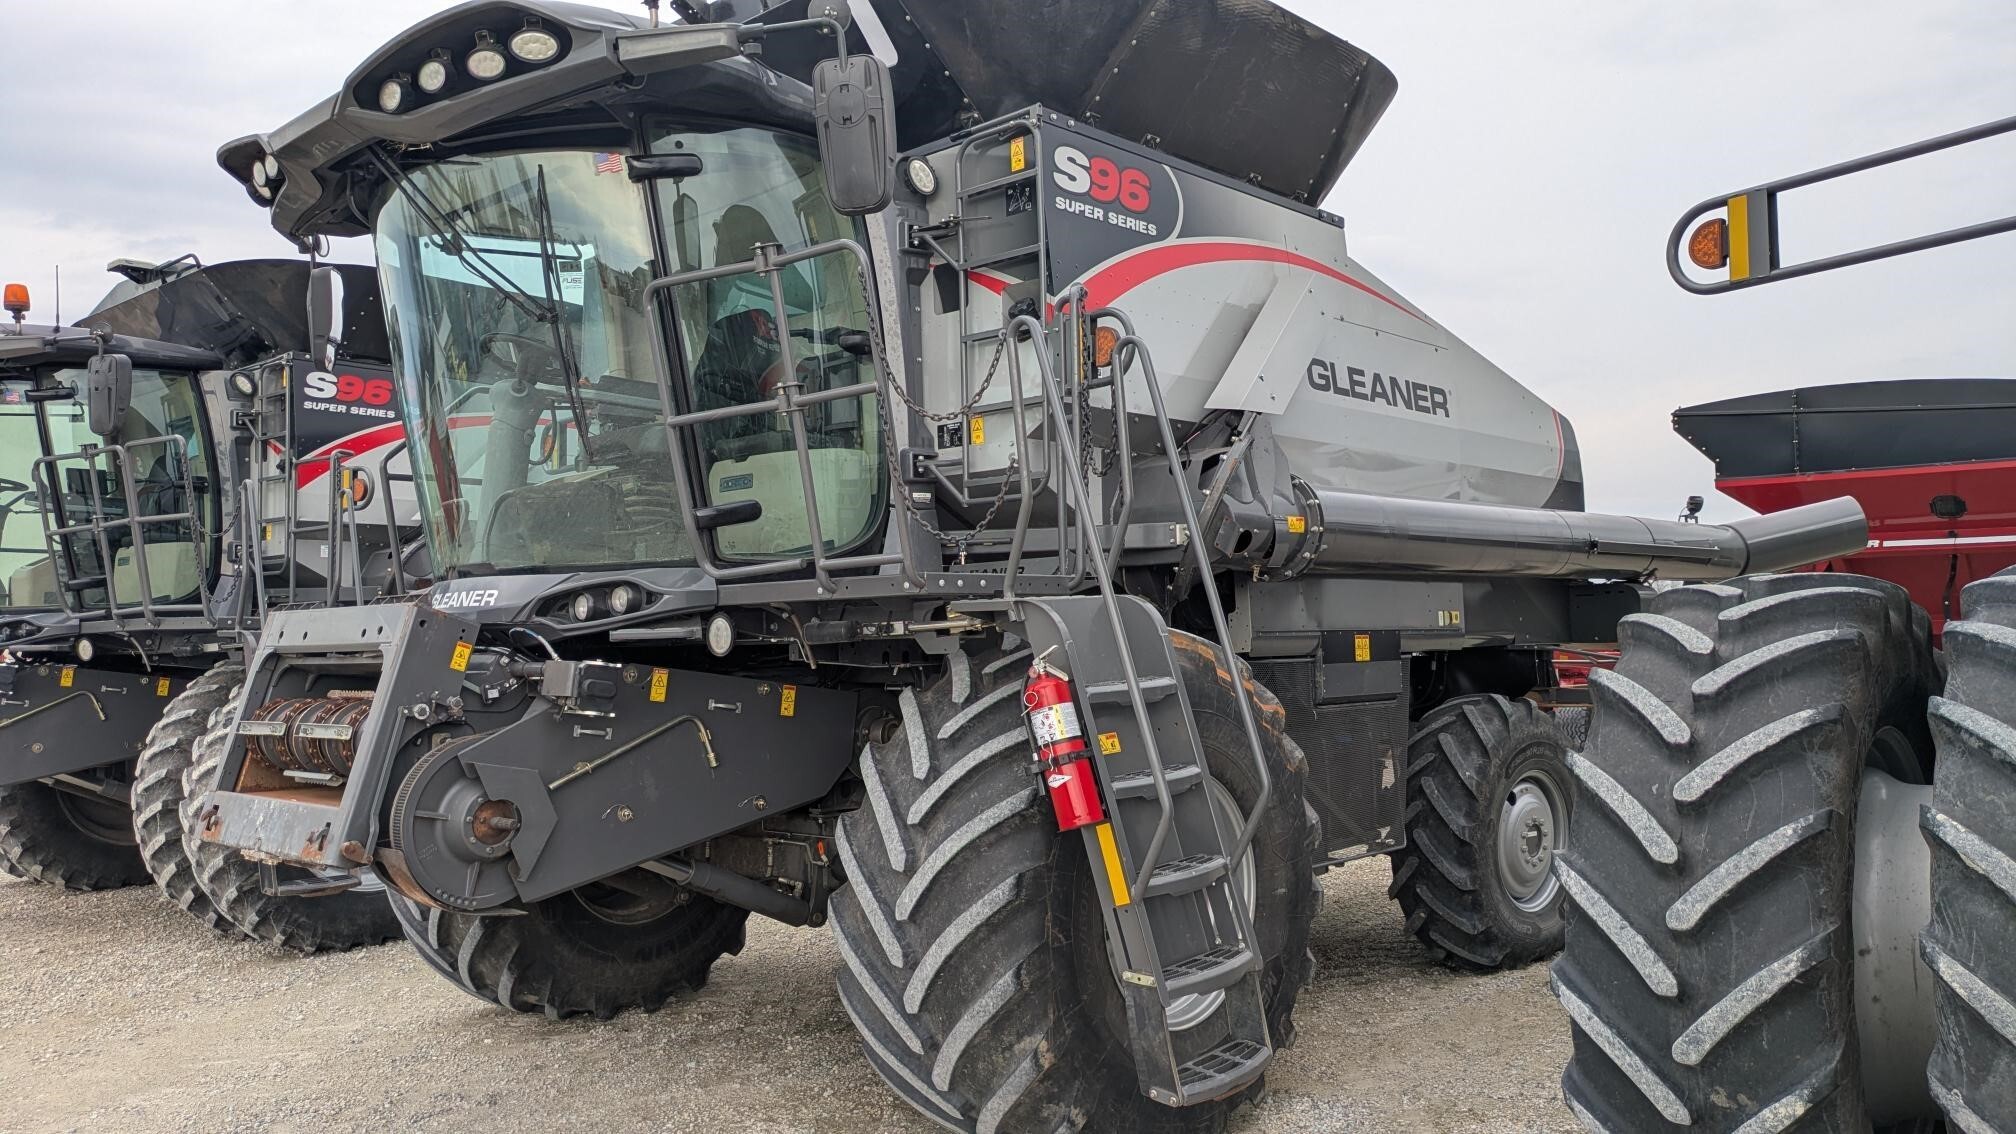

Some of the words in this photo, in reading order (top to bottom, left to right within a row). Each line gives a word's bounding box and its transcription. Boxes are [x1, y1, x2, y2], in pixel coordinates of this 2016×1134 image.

[1053, 145, 1151, 213] S96
[1055, 196, 1104, 222] SUPER
[1107, 211, 1157, 237] SERIES
[303, 371, 393, 405] S96
[1307, 357, 1450, 418] GLEANER
[303, 401, 347, 413] SUPER
[350, 406, 396, 419] SERIES
[432, 589, 499, 609] GLEANER
